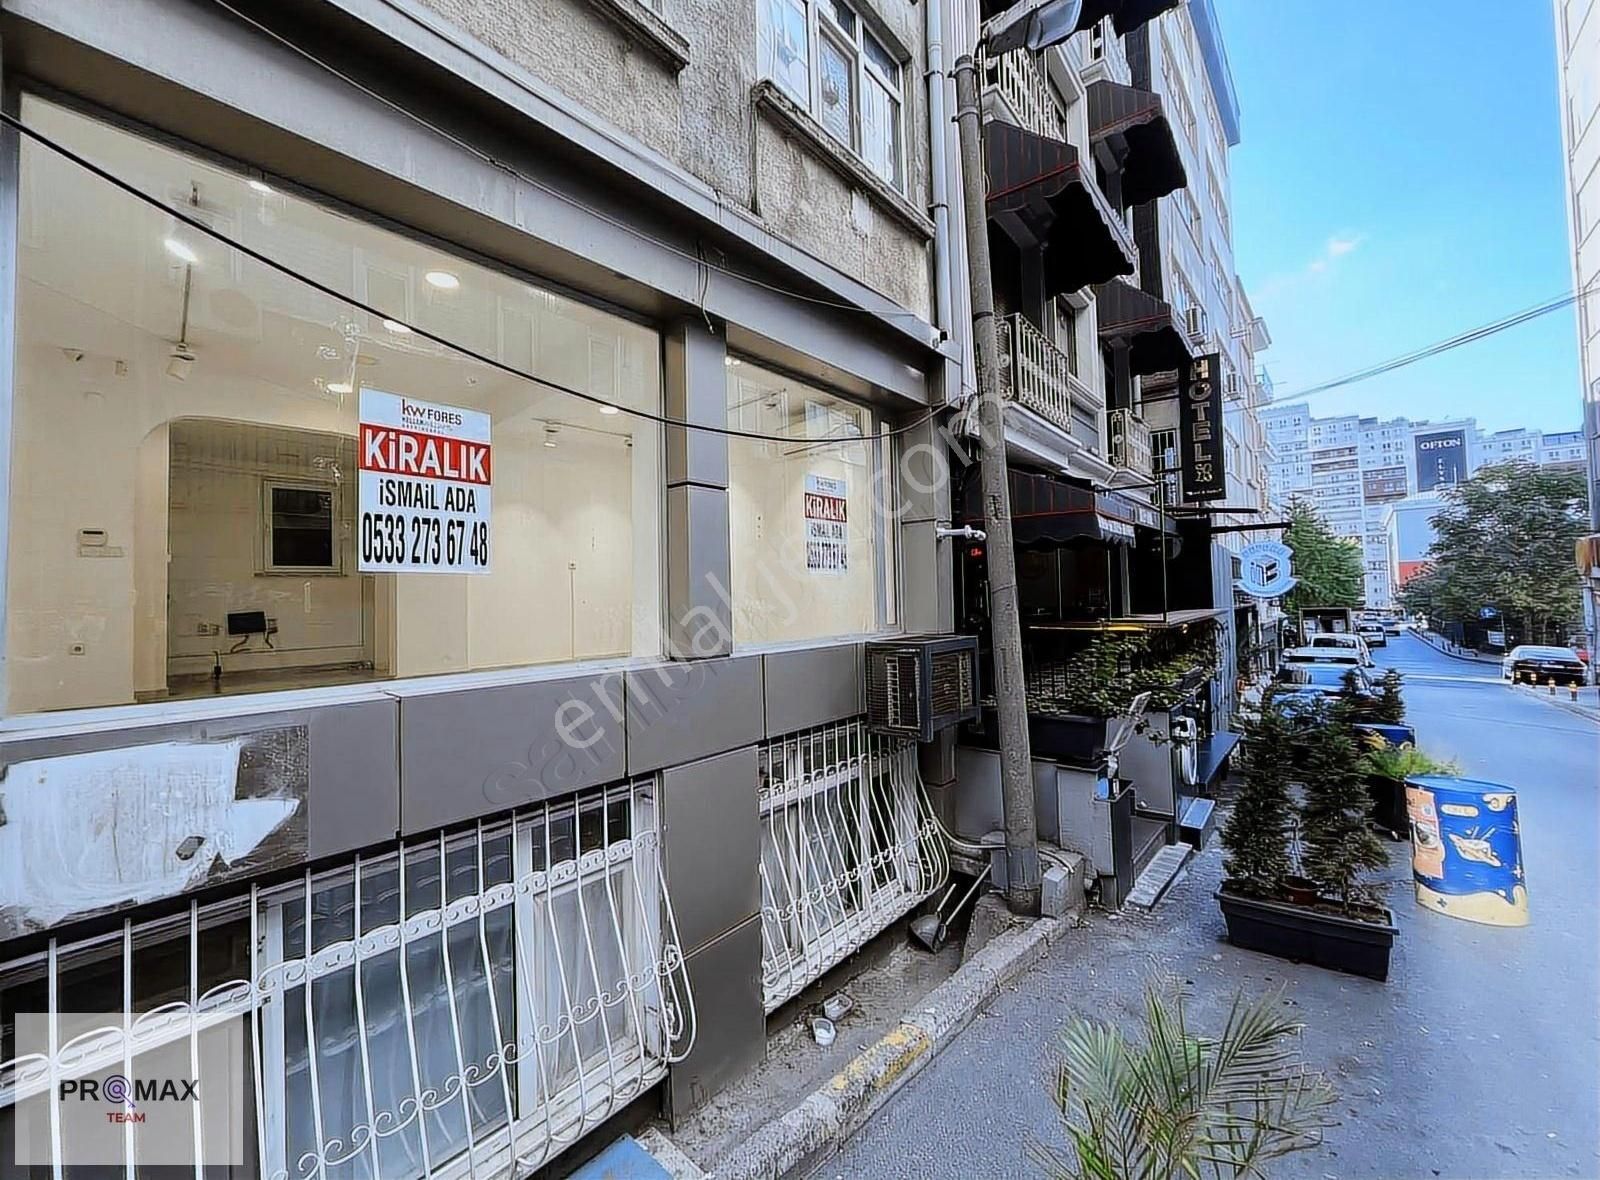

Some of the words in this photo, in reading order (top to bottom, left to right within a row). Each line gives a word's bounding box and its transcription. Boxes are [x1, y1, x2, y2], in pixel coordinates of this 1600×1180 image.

[427, 408, 462, 425] FORES
[1189, 359, 1213, 462] HOTEL
[445, 486, 476, 513] ADA
[362, 512, 405, 563] 0533
[411, 517, 440, 565] 273
[447, 521, 465, 565] 67
[470, 521, 488, 566] 48
